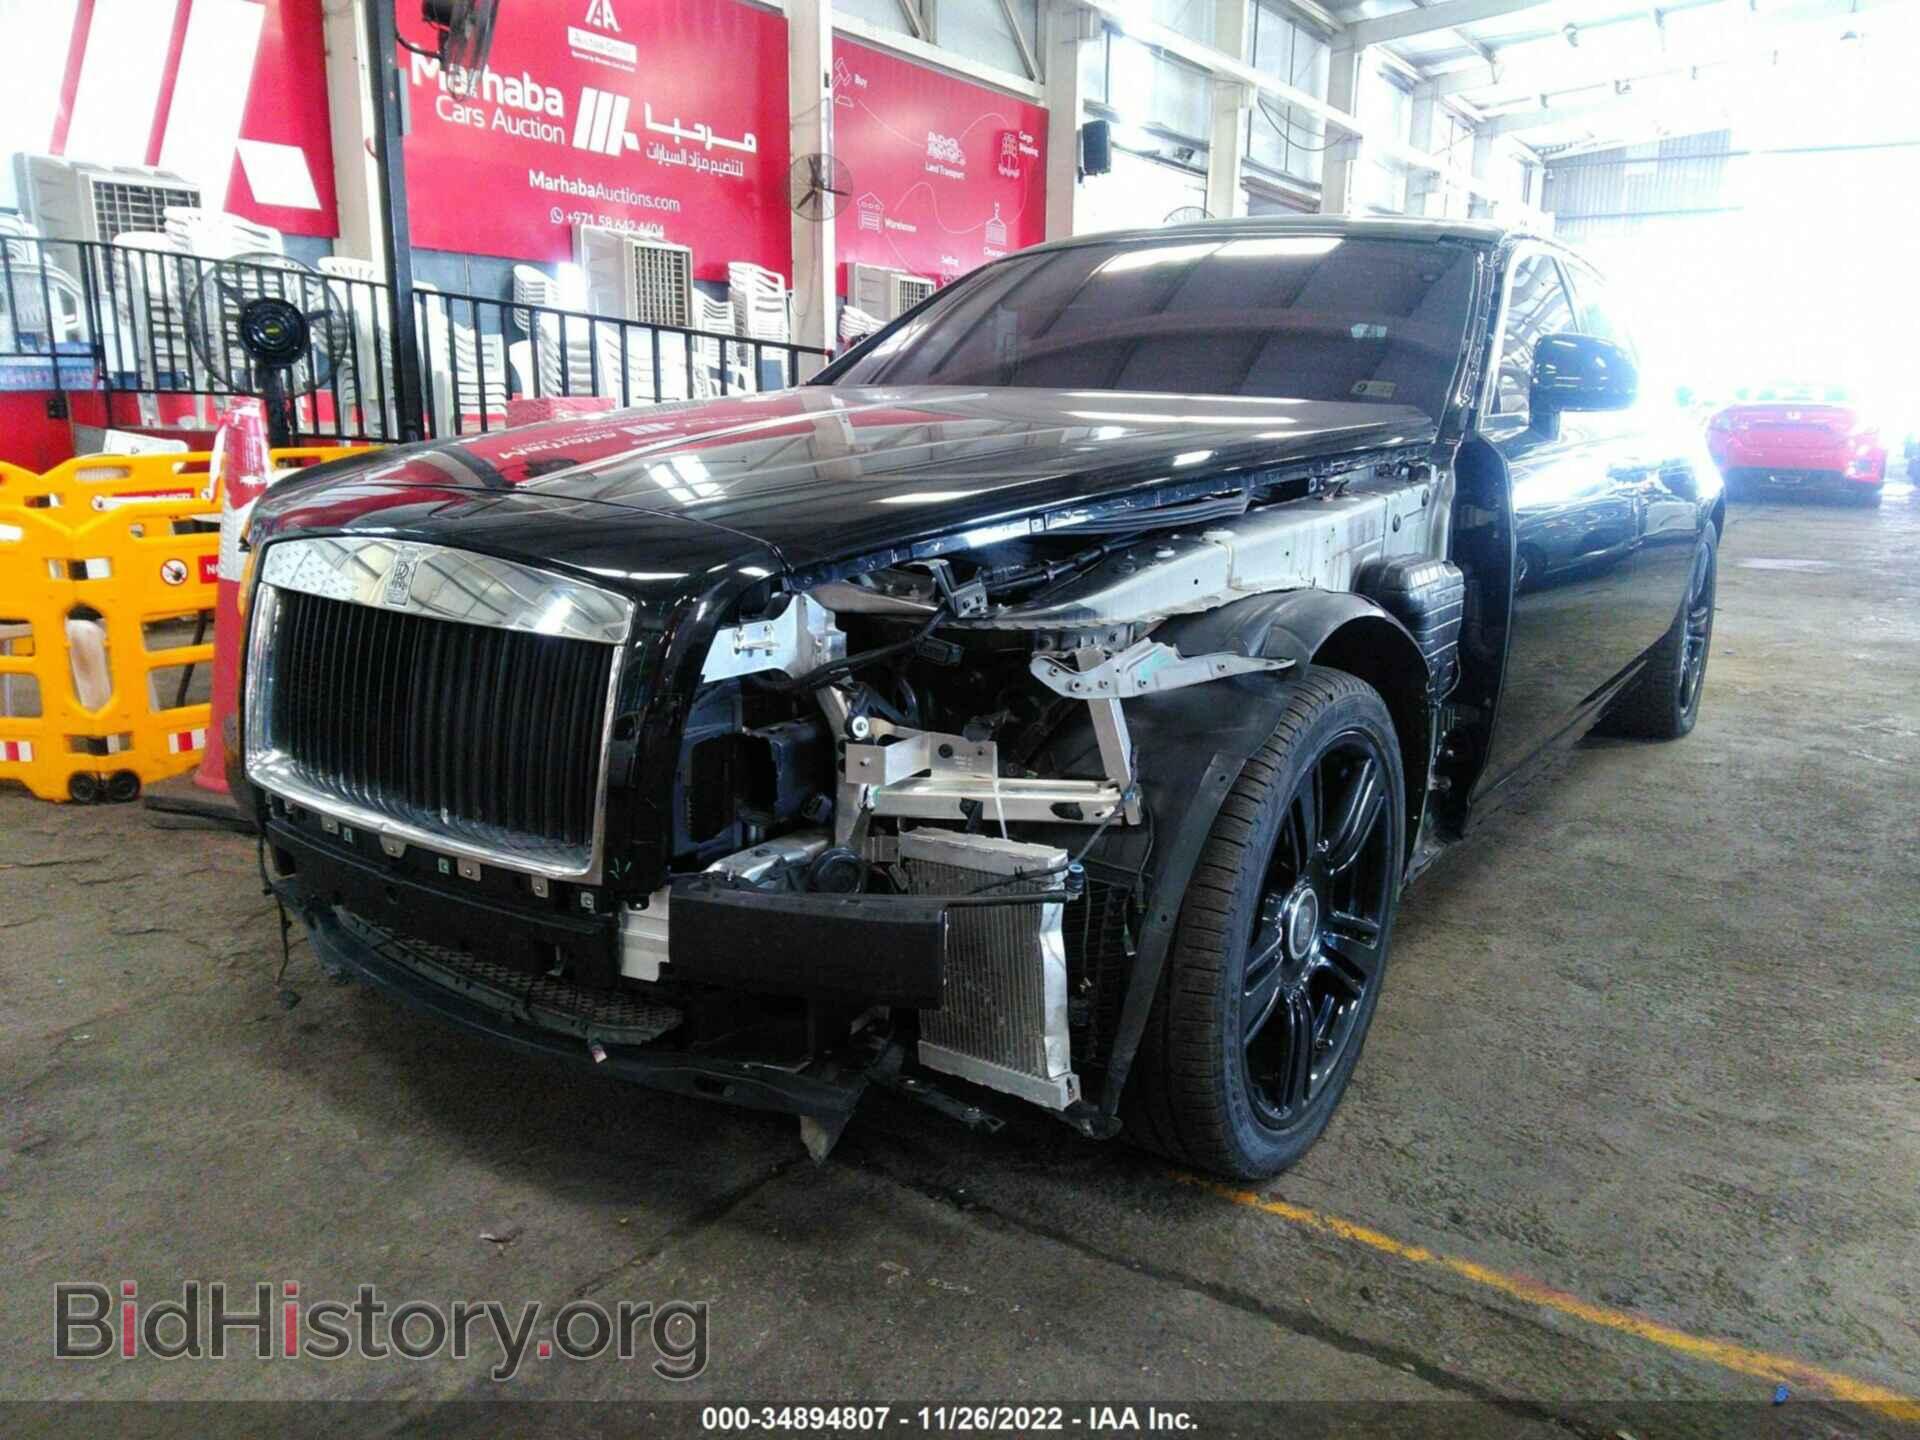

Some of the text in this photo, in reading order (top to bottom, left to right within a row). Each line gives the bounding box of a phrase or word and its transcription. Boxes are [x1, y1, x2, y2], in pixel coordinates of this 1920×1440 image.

[410, 43, 564, 118] Marhaba
[435, 95, 565, 144] Cars Auction
[528, 168, 681, 212] MarhabaAuctions.com
